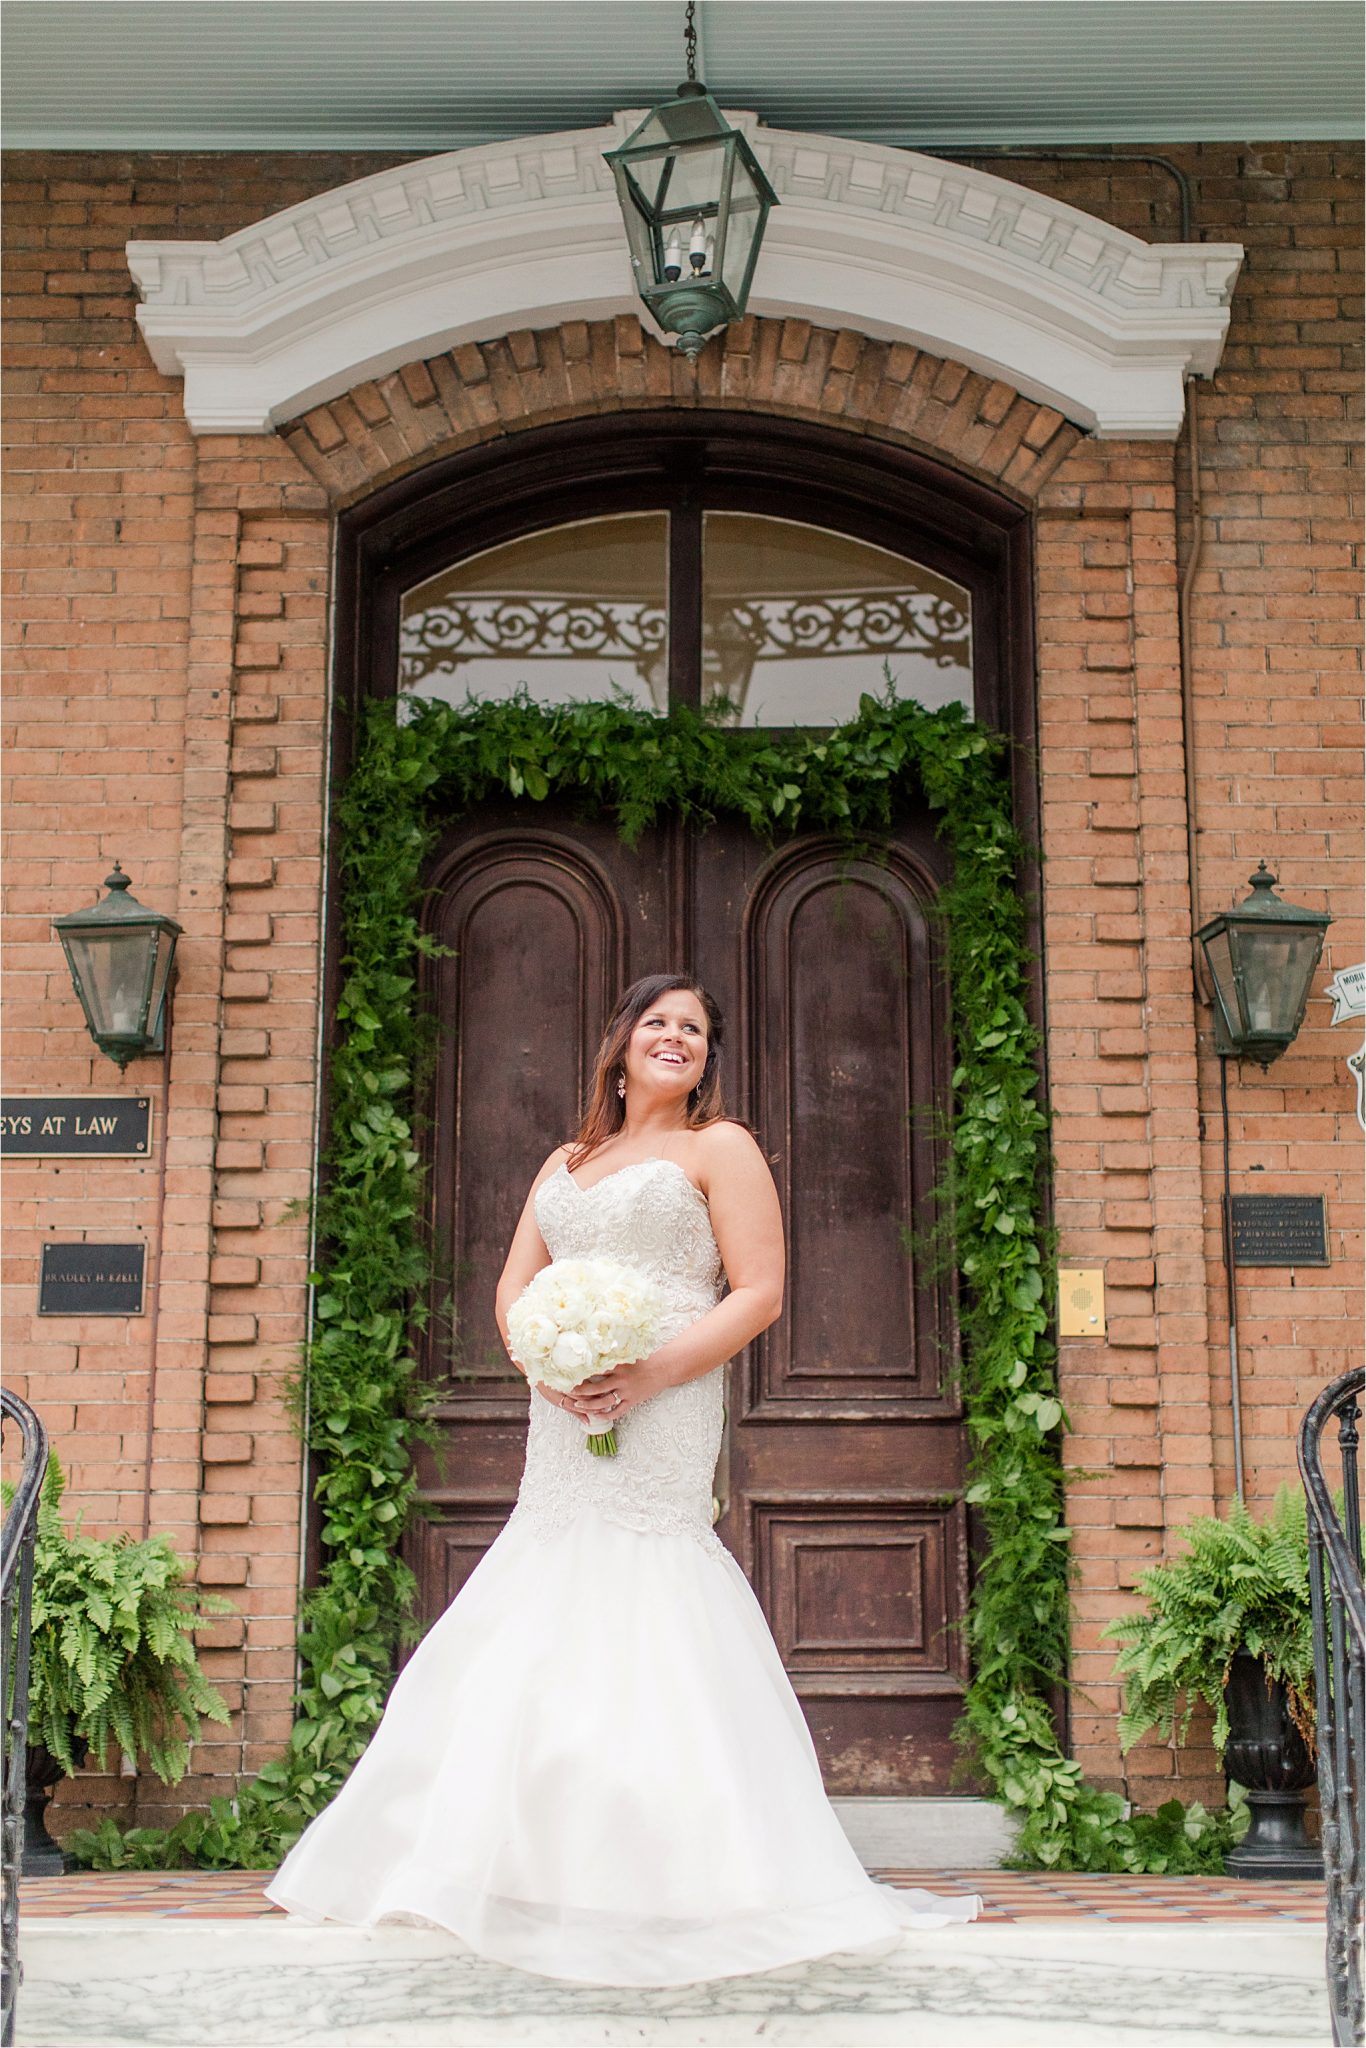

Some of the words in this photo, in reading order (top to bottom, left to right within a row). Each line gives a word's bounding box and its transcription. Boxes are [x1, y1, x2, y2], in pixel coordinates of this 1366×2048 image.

[40, 1116, 66, 1135] AT
[75, 1116, 118, 1135] LAW
[44, 1273, 92, 1283] BRADLEY
